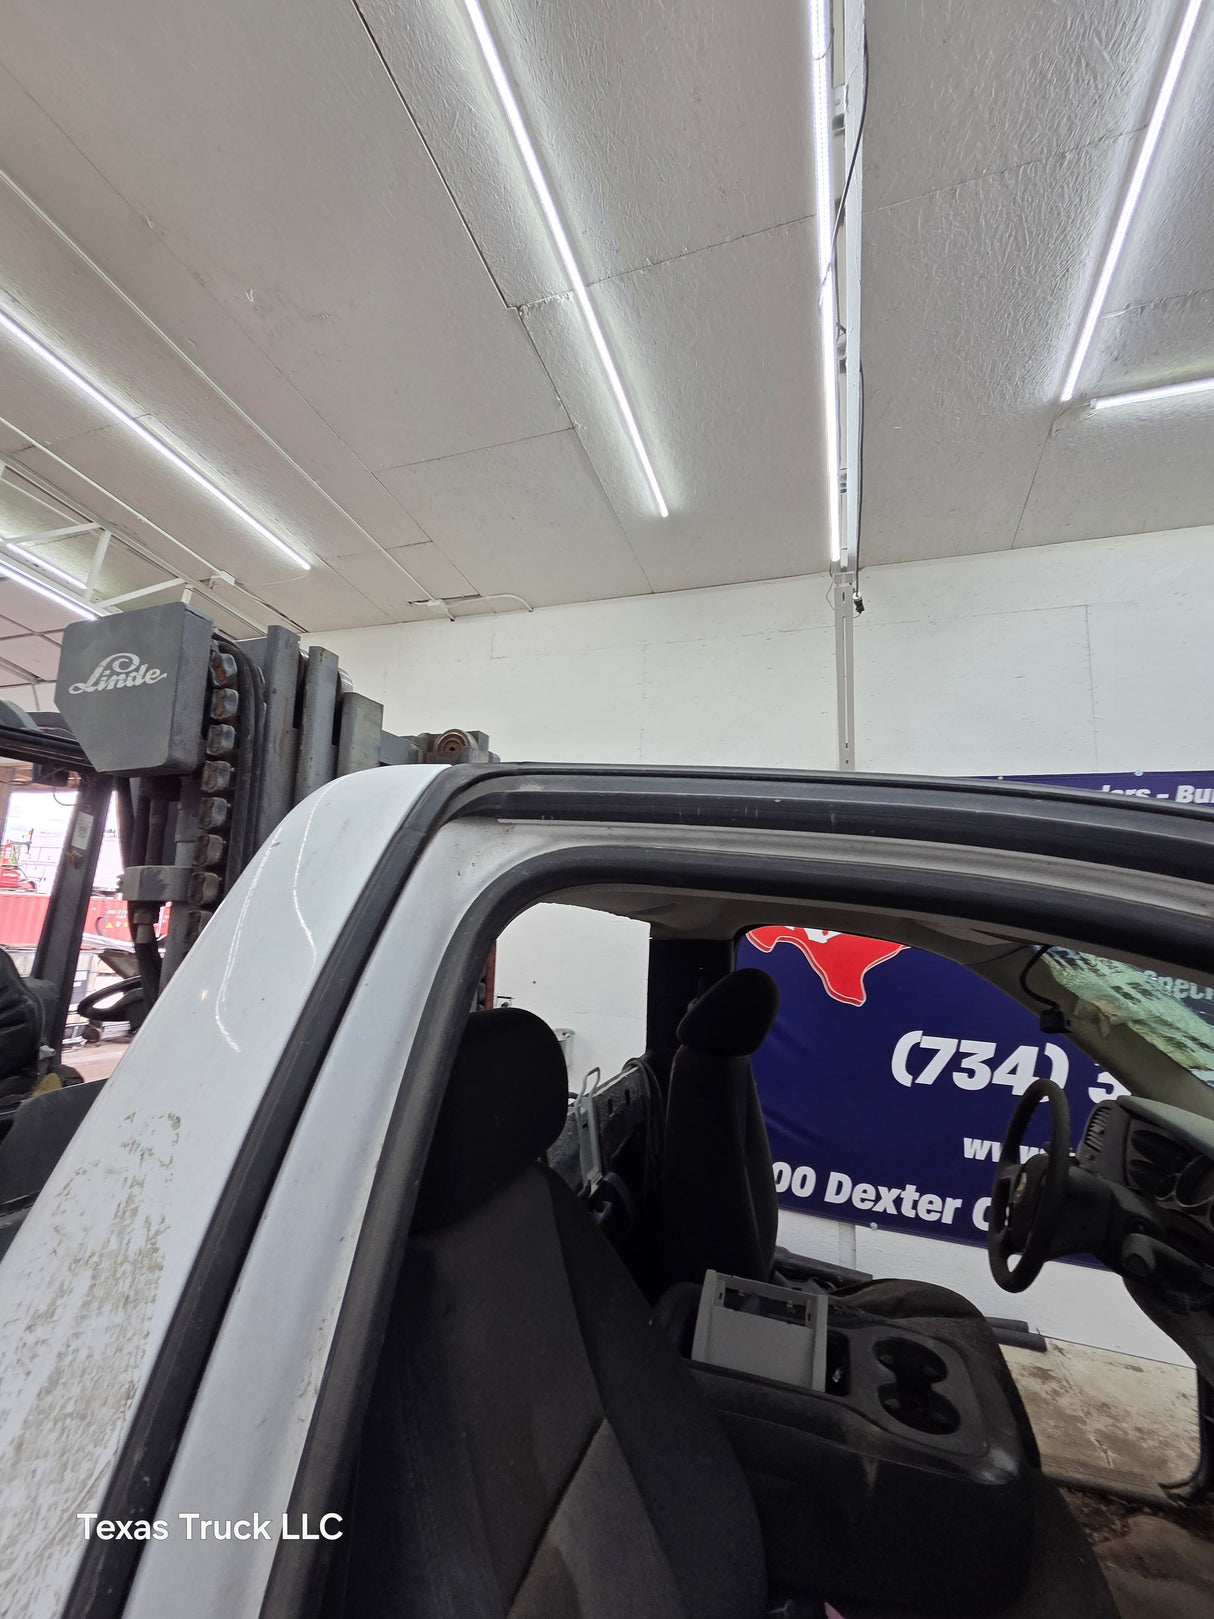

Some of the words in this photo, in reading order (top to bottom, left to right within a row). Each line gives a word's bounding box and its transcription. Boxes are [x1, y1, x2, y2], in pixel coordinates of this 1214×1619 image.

[68, 653, 167, 694] Linde
[1175, 785, 1214, 803] Bu
[891, 1030, 1070, 1102] (734)
[772, 1161, 817, 1198] 00
[824, 1171, 962, 1225] Dexter
